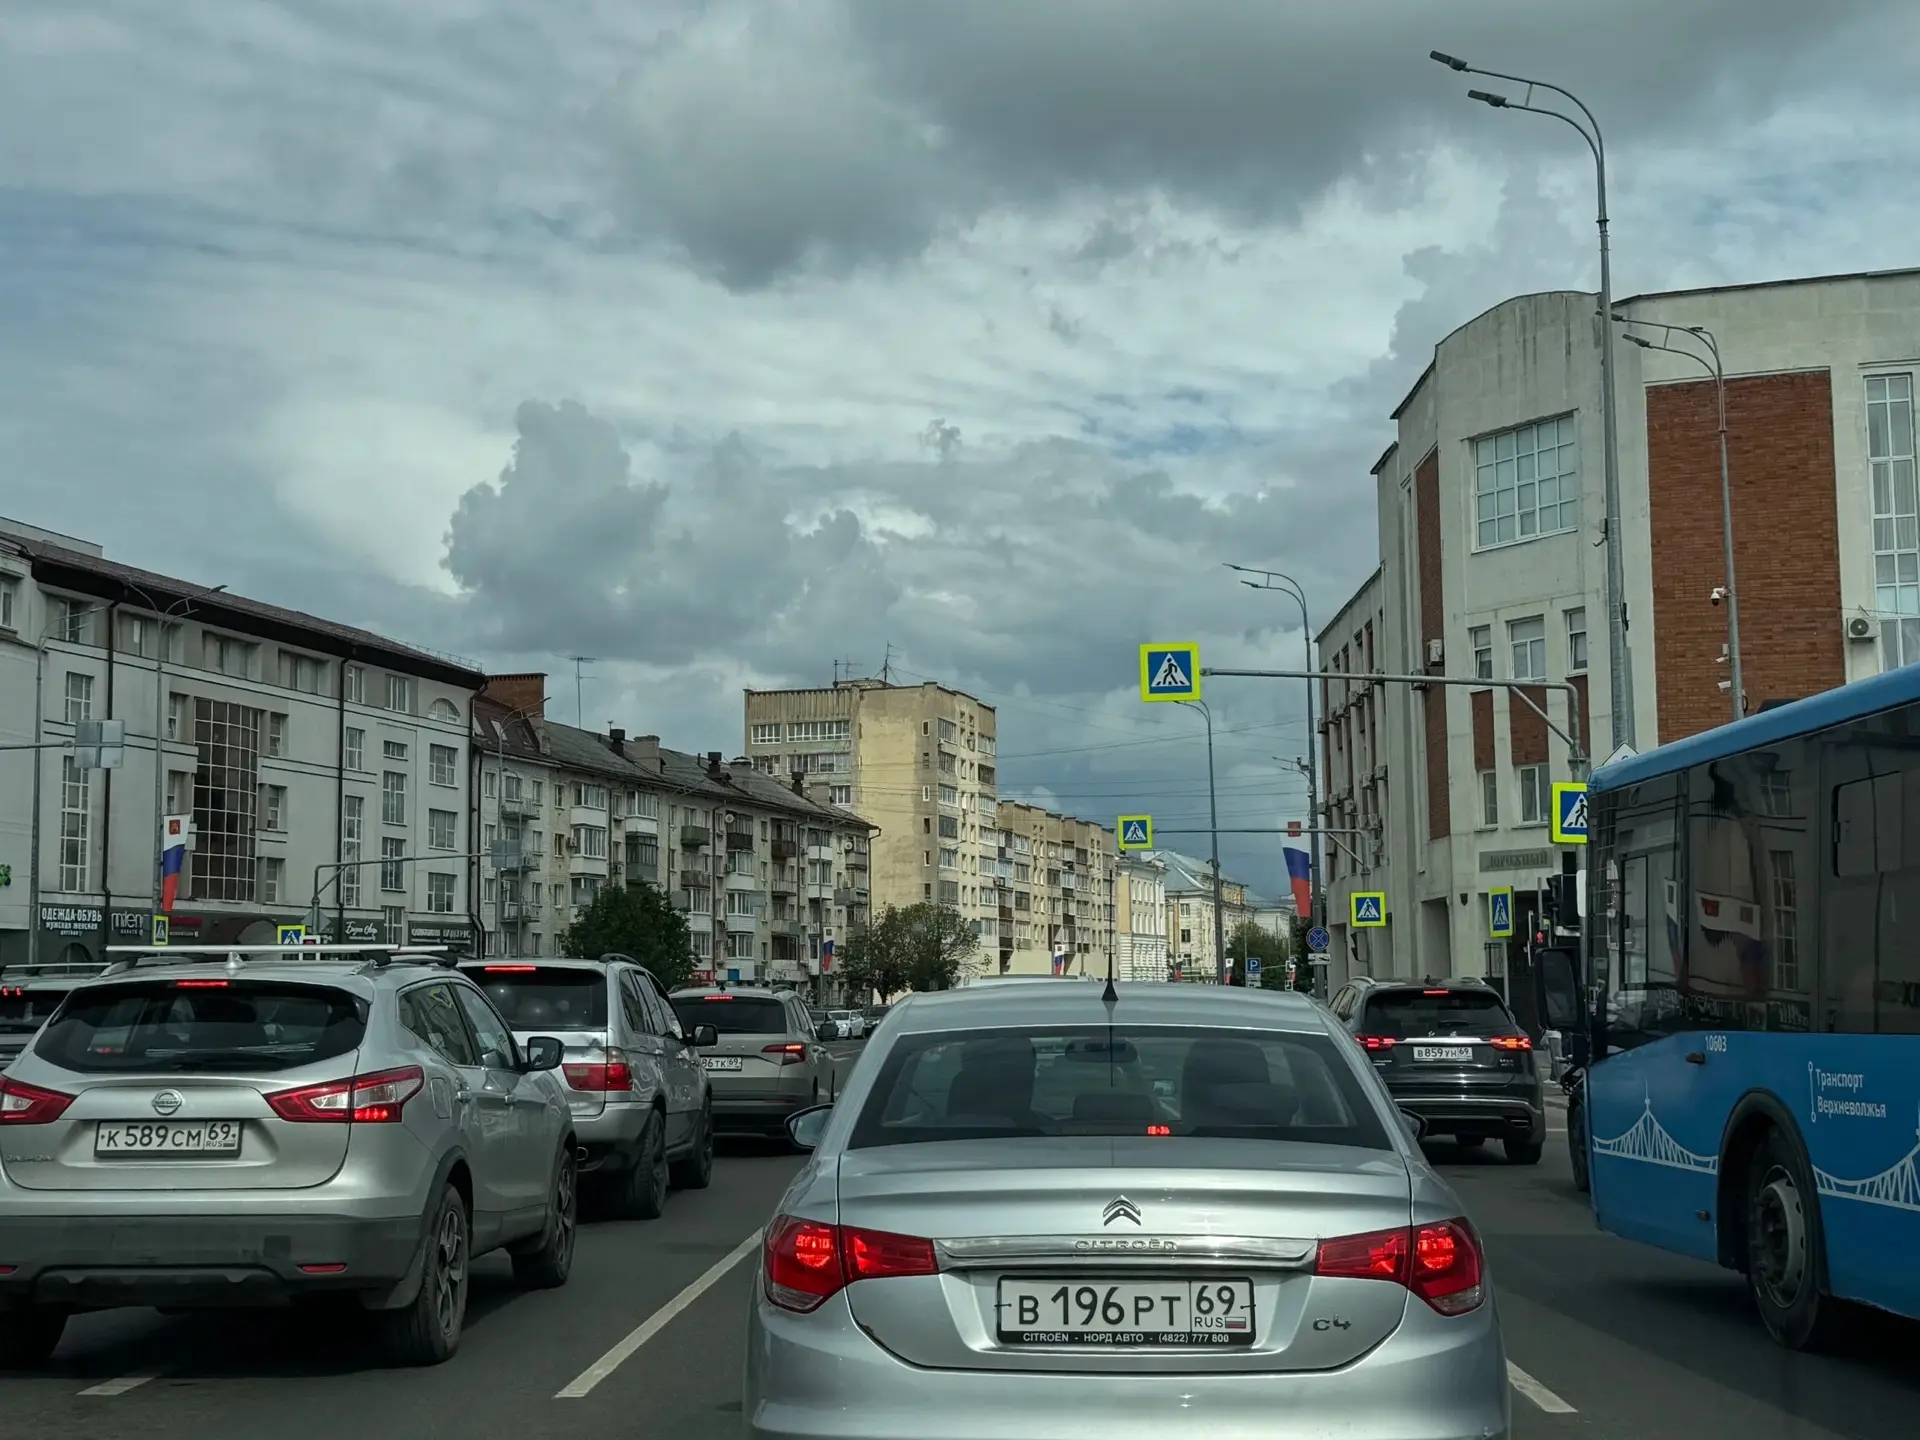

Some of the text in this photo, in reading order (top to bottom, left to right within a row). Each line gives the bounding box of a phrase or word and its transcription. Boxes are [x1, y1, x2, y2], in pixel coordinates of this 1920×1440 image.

[1250, 960, 1258, 970] P
[1458, 1047, 1469, 1056] 69
[1705, 1035, 1727, 1052] 10603
[728, 1058, 738, 1066] 69
[1815, 1068, 1864, 1093] Транспорт
[1817, 1095, 1887, 1119] Верхневолжья
[208, 1123, 231, 1141] 69
[1195, 1285, 1235, 1316] 69
[1194, 1317, 1224, 1328] RUS
[1312, 1314, 1352, 1331] C4
[1083, 1333, 1113, 1343] НОРД
[1115, 1334, 1144, 1342] АВТО
[1158, 1333, 1189, 1344] (4822)
[1192, 1334, 1209, 1343] 777
[1211, 1334, 1230, 1343] 800
